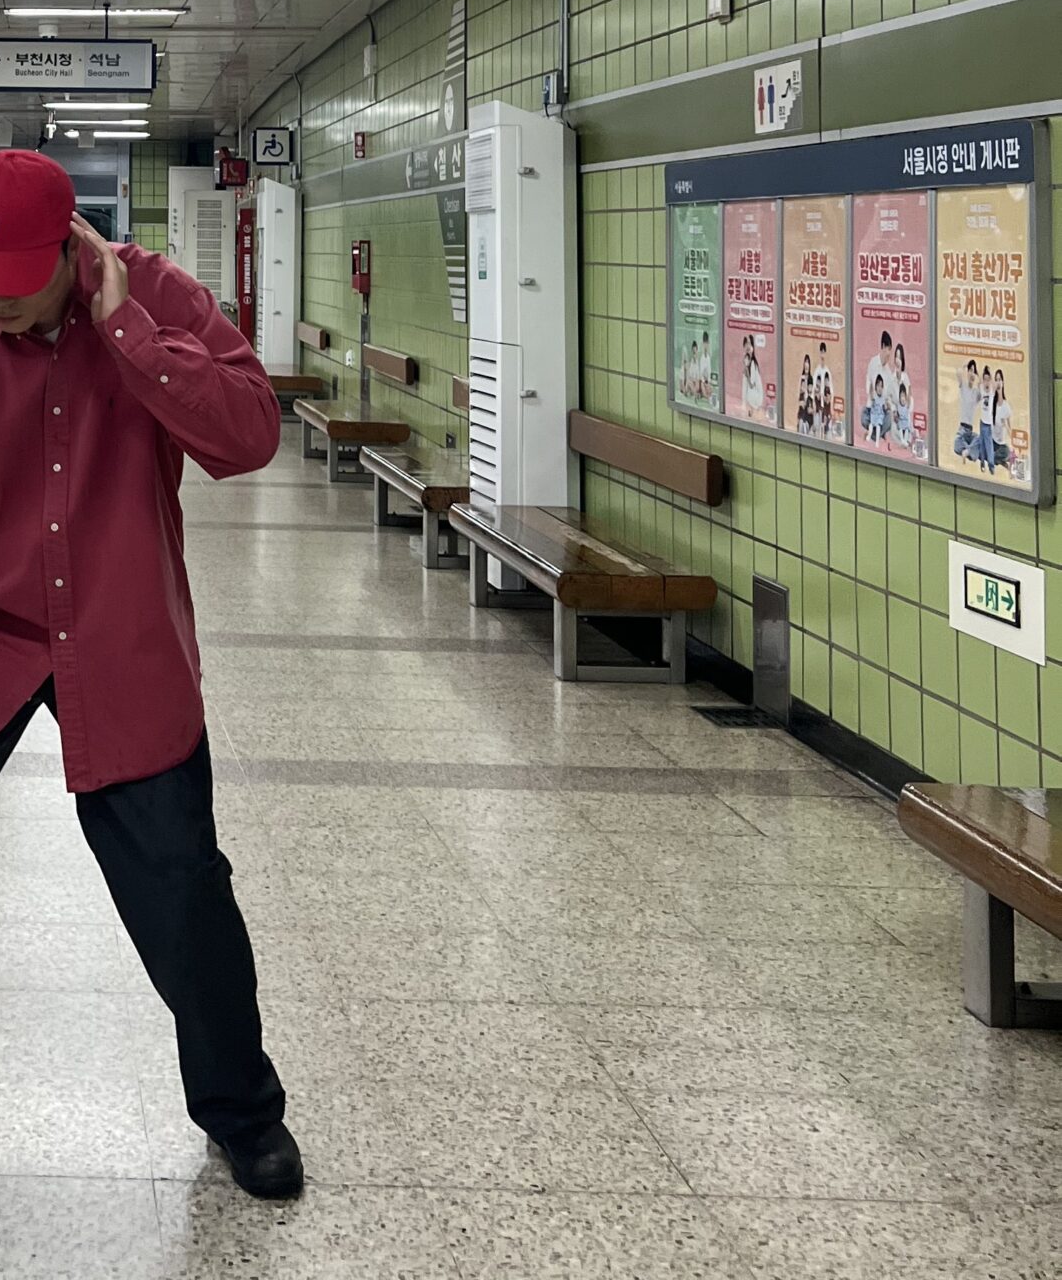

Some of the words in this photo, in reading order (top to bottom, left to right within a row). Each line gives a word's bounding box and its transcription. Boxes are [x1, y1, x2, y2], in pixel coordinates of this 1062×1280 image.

[15, 53, 72, 66] 부천시청
[89, 53, 121, 66] 석남
[15, 69, 43, 77] Bucheon
[45, 69, 58, 77] City
[60, 69, 73, 77] Hall
[87, 70, 130, 78] Seongnam
[903, 145, 948, 176] 서울시정
[951, 141, 976, 173] 안내
[980, 137, 1020, 170] 게시판
[739, 250, 761, 273] 서울형
[859, 254, 922, 283] 임산부교통비
[943, 252, 967, 281] 자녀
[971, 250, 1023, 283] 출산가구
[728, 278, 742, 301] 주말
[743, 279, 774, 304] 어린이집
[789, 281, 841, 308] 산후조리경비
[949, 287, 987, 317] 주거비
[991, 289, 1017, 321] 지원
